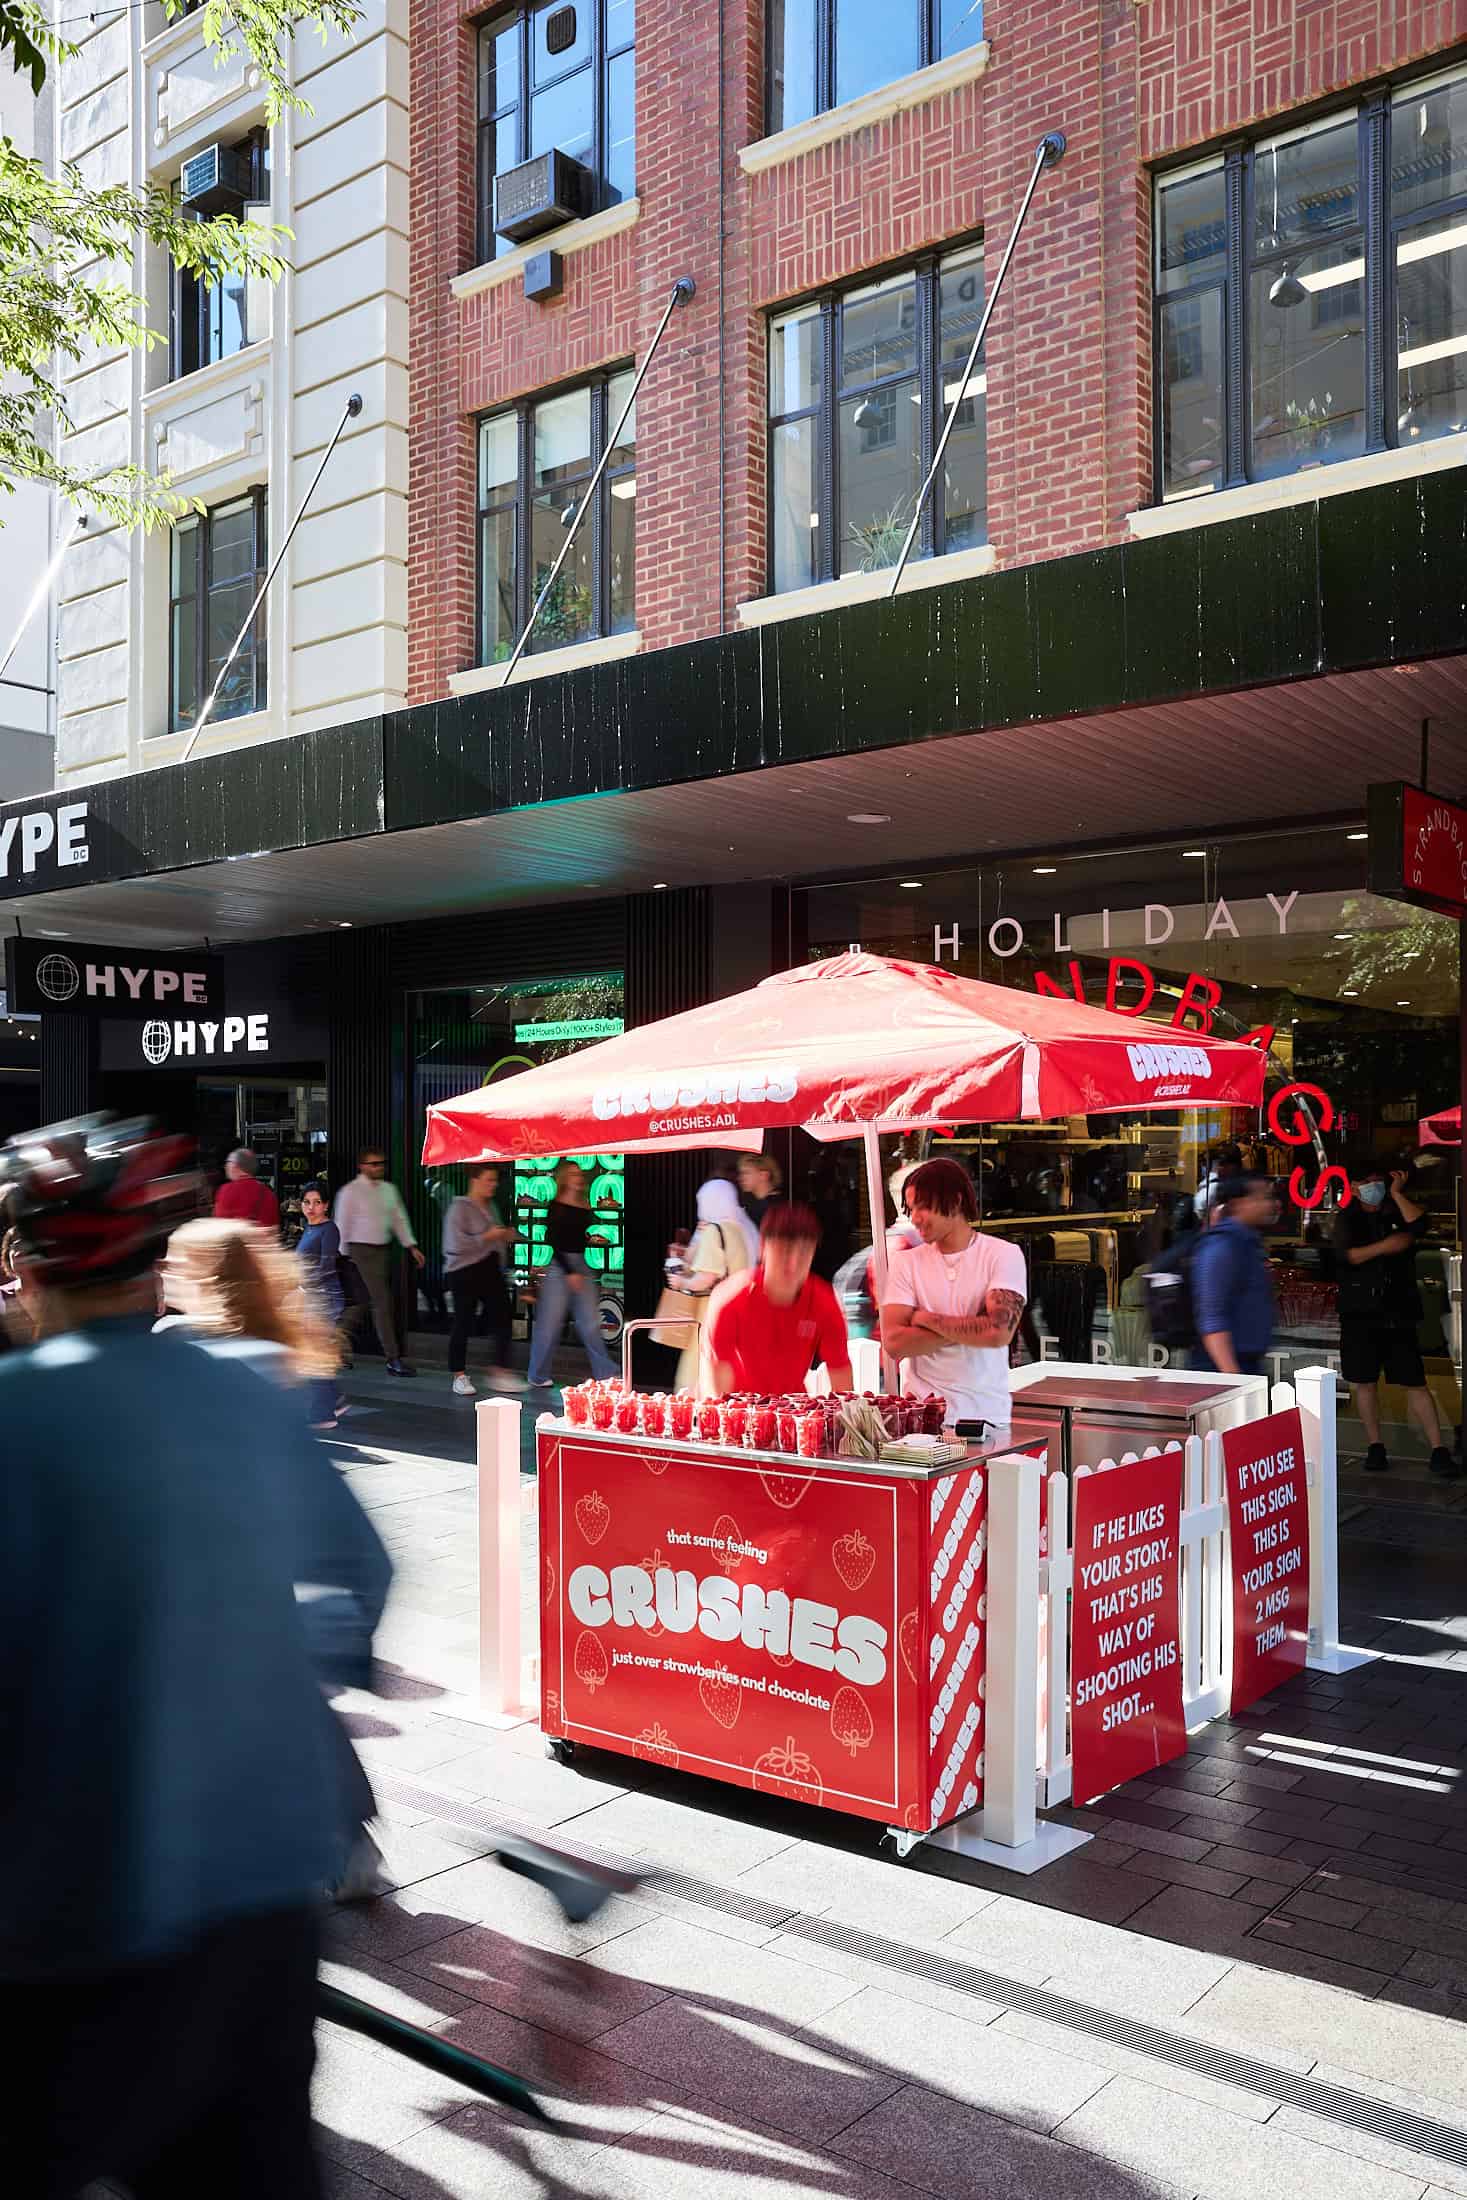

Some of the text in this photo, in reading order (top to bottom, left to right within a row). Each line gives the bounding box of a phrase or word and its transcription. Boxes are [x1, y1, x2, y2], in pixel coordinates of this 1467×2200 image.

[1413, 807, 1467, 900] STRANDBAG
[933, 890, 1299, 962] HOLIDAY
[86, 964, 208, 1004] HYPE
[174, 1014, 269, 1056] HYPE
[649, 1113, 739, 1133] @CRUSHES.ADL
[1238, 1448, 1295, 1490] IF YOU SEE
[1241, 1482, 1297, 1525] THIS SIGN.
[666, 1528, 768, 1564] that same feeling
[1092, 1504, 1165, 1549] IF HE LIKES
[1253, 1518, 1290, 1555] THIS IS
[1080, 1536, 1173, 1590] YOUR STORY.
[1242, 1545, 1301, 1595] YOUR SIGN
[1090, 1574, 1163, 1624] THAT'S HIS
[1255, 1586, 1290, 1624] 2 MSG
[568, 1565, 887, 1686] CRUSHES
[1098, 1613, 1156, 1658] WAY OF
[1255, 1621, 1287, 1656] THEM.
[611, 1648, 831, 1711] just over strawberries and chocolate
[1075, 1640, 1177, 1706] SHOOTING HIS
[1101, 1692, 1154, 1732] SHOT...
